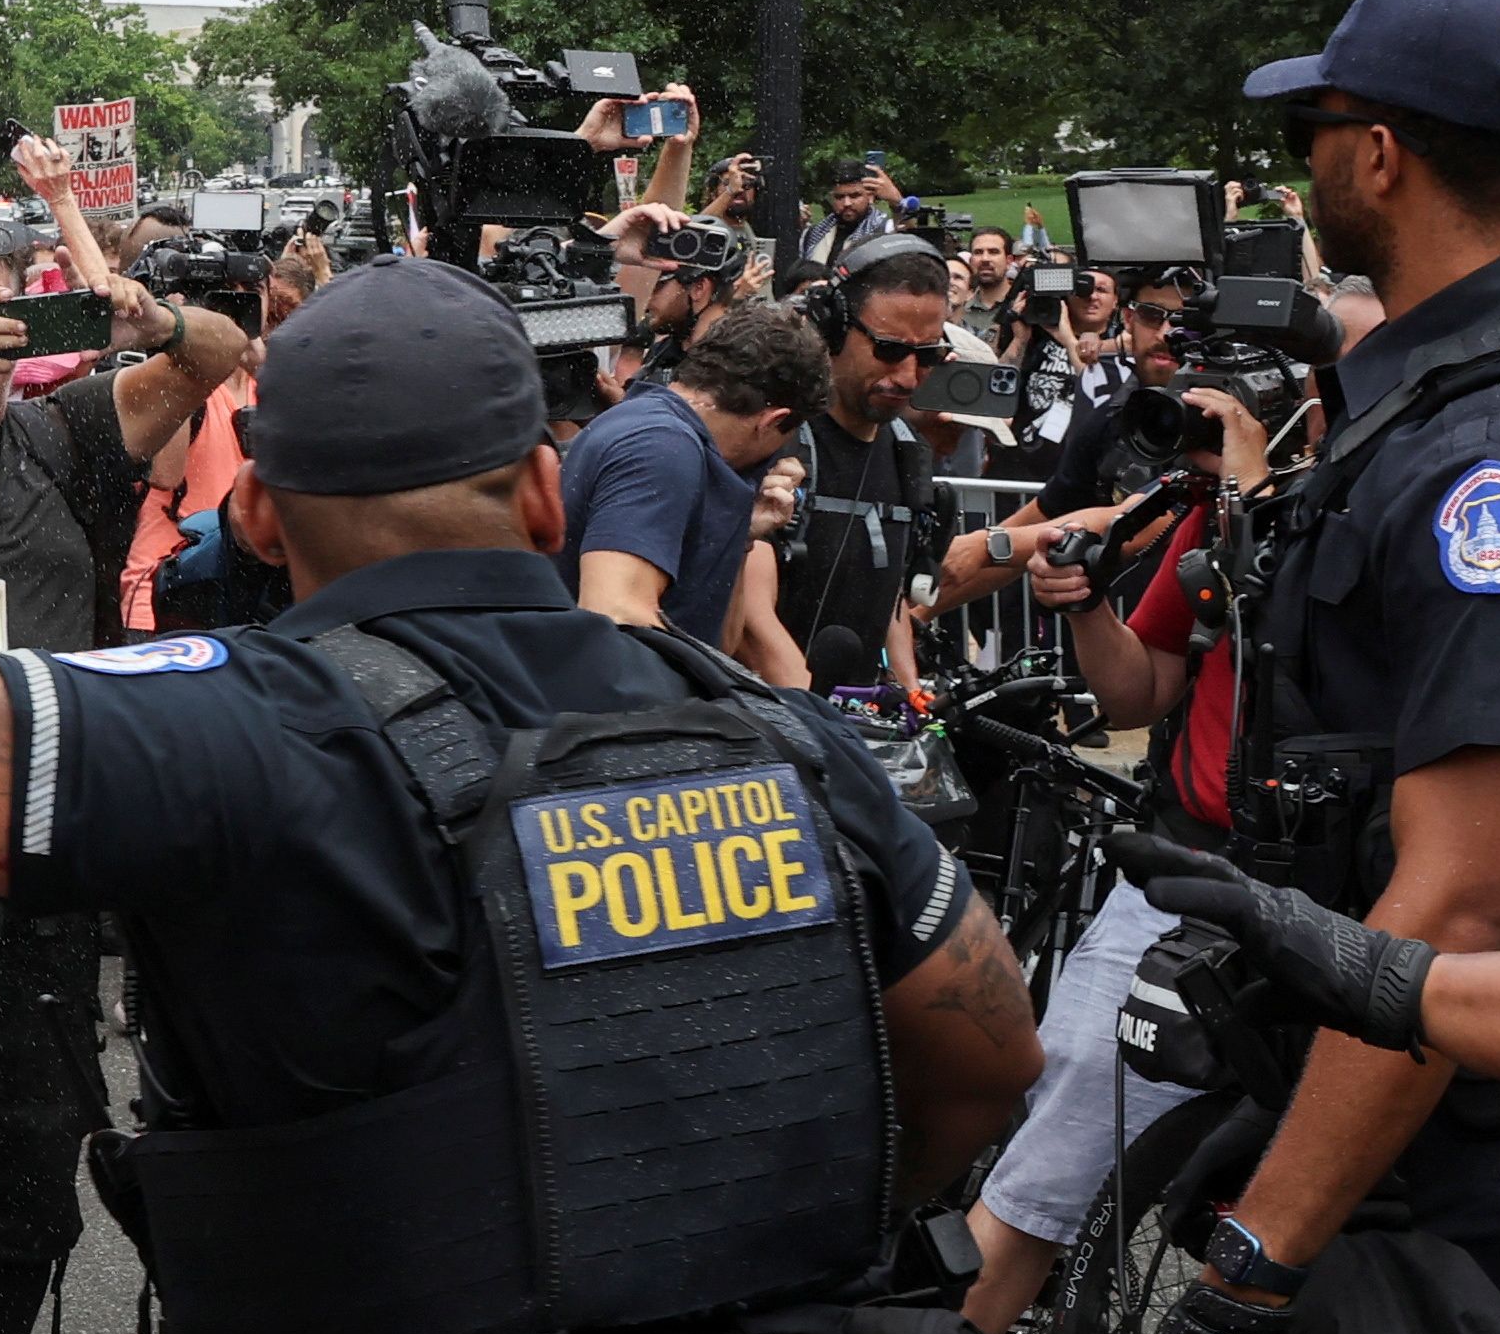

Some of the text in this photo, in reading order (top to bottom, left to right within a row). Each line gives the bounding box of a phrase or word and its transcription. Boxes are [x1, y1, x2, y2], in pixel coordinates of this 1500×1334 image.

[59, 99, 132, 130] WANTED
[70, 162, 134, 190] ENJAMIN
[73, 184, 134, 209] TANYAHU
[1256, 299, 1281, 307] SONY
[1442, 495, 1460, 526] UNITED
[538, 778, 797, 855] U.S. CAPITOL
[546, 827, 819, 948] POLICE
[1117, 1011, 1159, 1053] POLICE
[1064, 1194, 1117, 1309] XR3 COMP
